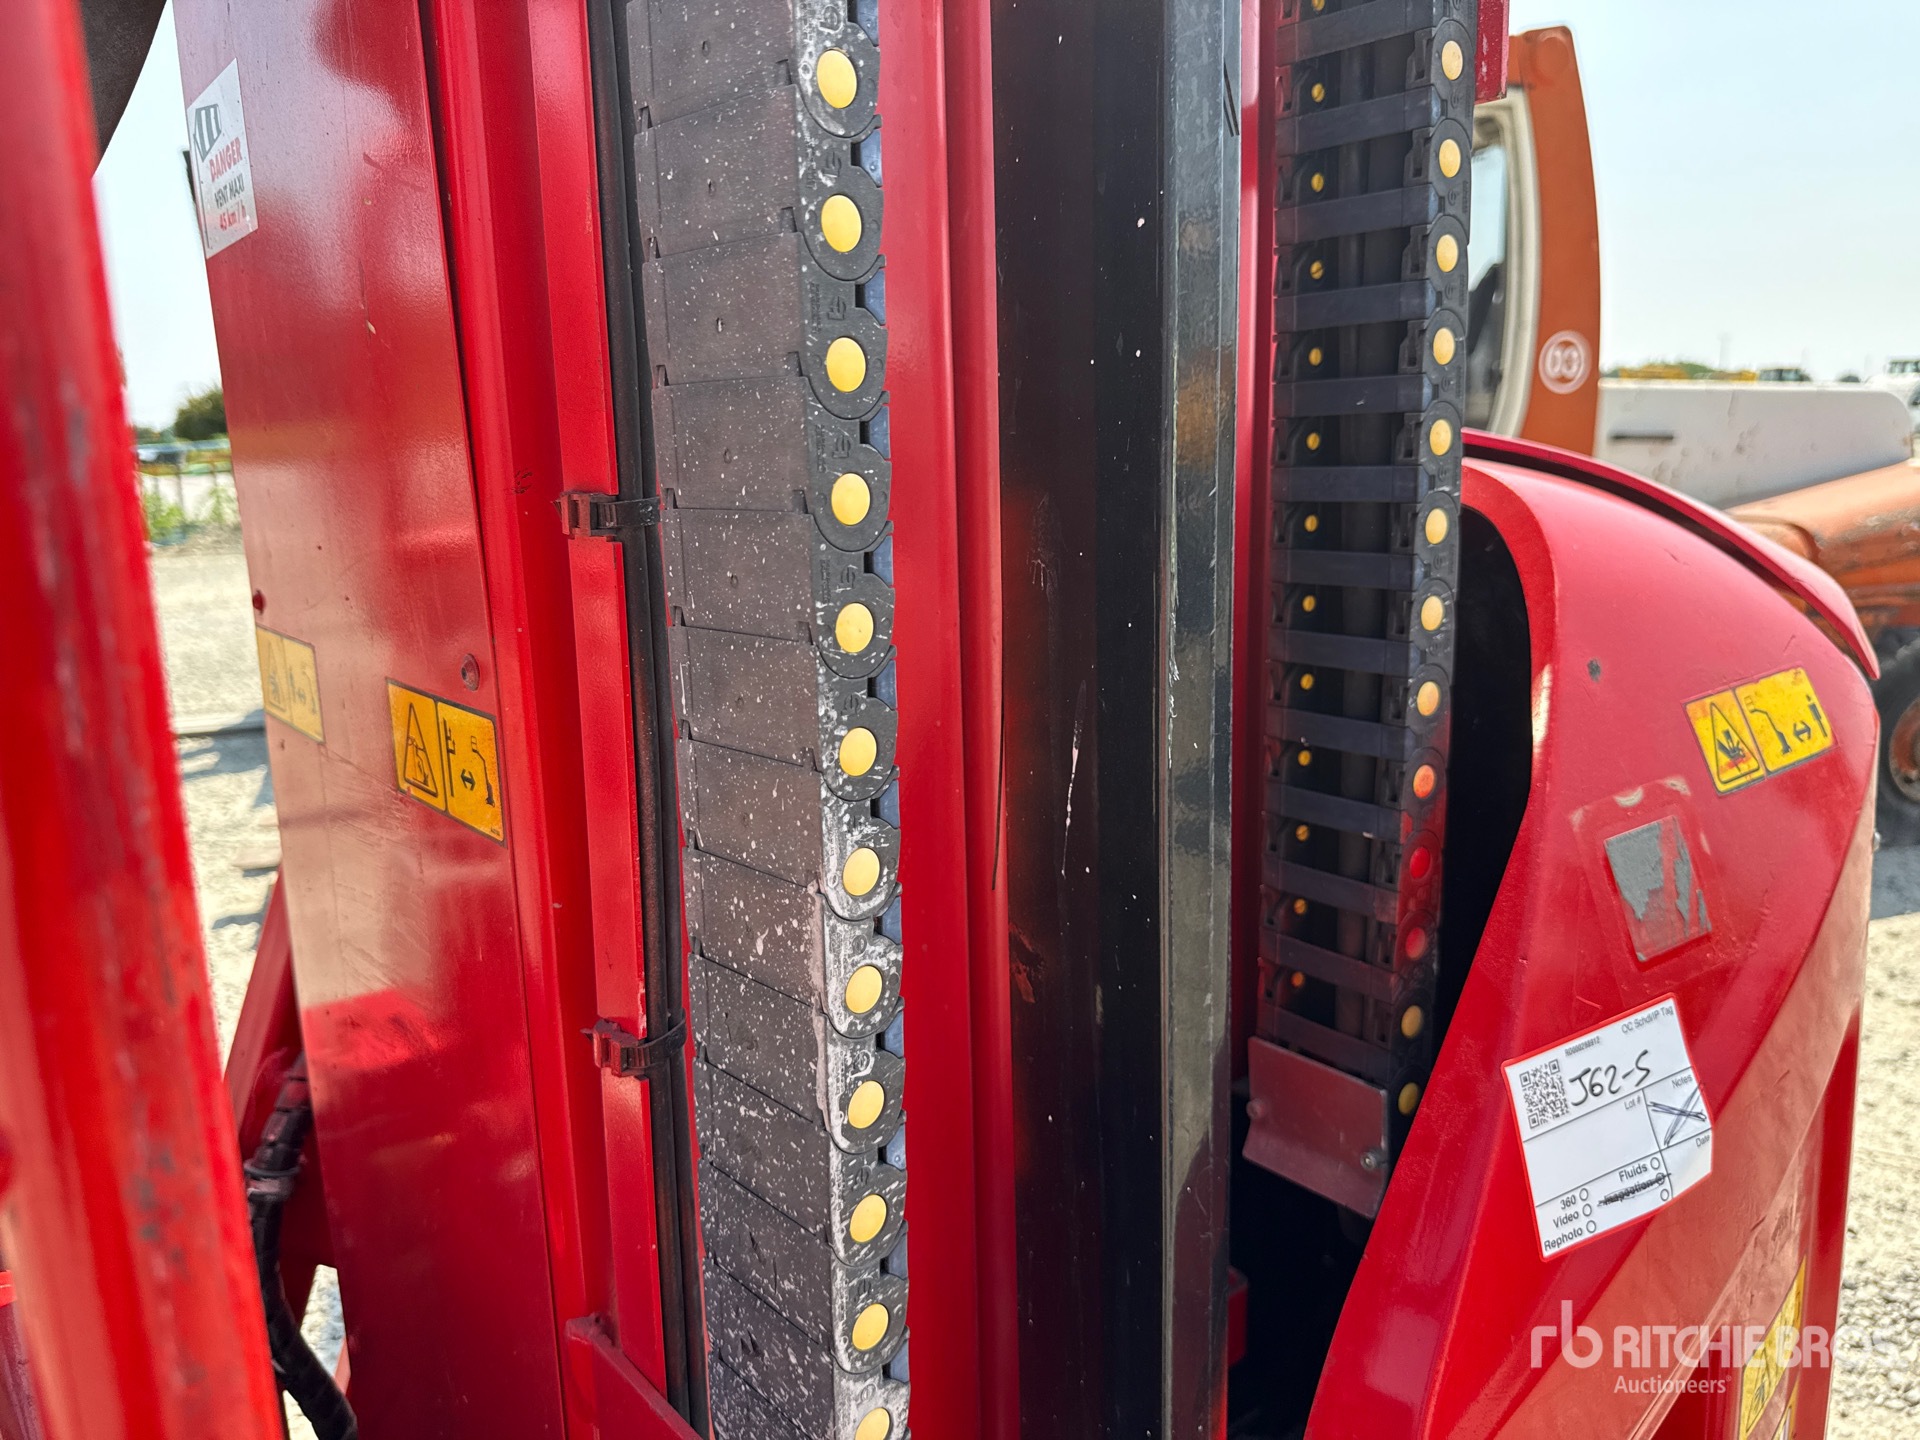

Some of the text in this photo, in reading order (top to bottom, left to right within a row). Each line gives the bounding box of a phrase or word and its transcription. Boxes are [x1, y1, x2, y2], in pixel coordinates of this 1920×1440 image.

[209, 136, 242, 182] DANGER
[214, 173, 245, 209] VENT MAXI
[1661, 1005, 1674, 1016] Tag
[1672, 1074, 1692, 1089] Notes
[1623, 1100, 1637, 1112] Lot
[1695, 1133, 1711, 1149] Date
[1619, 1163, 1647, 1182] Fluids
[1560, 1194, 1577, 1210] 360
[1553, 1211, 1579, 1228] Video
[1544, 1227, 1583, 1252] Rephoto
